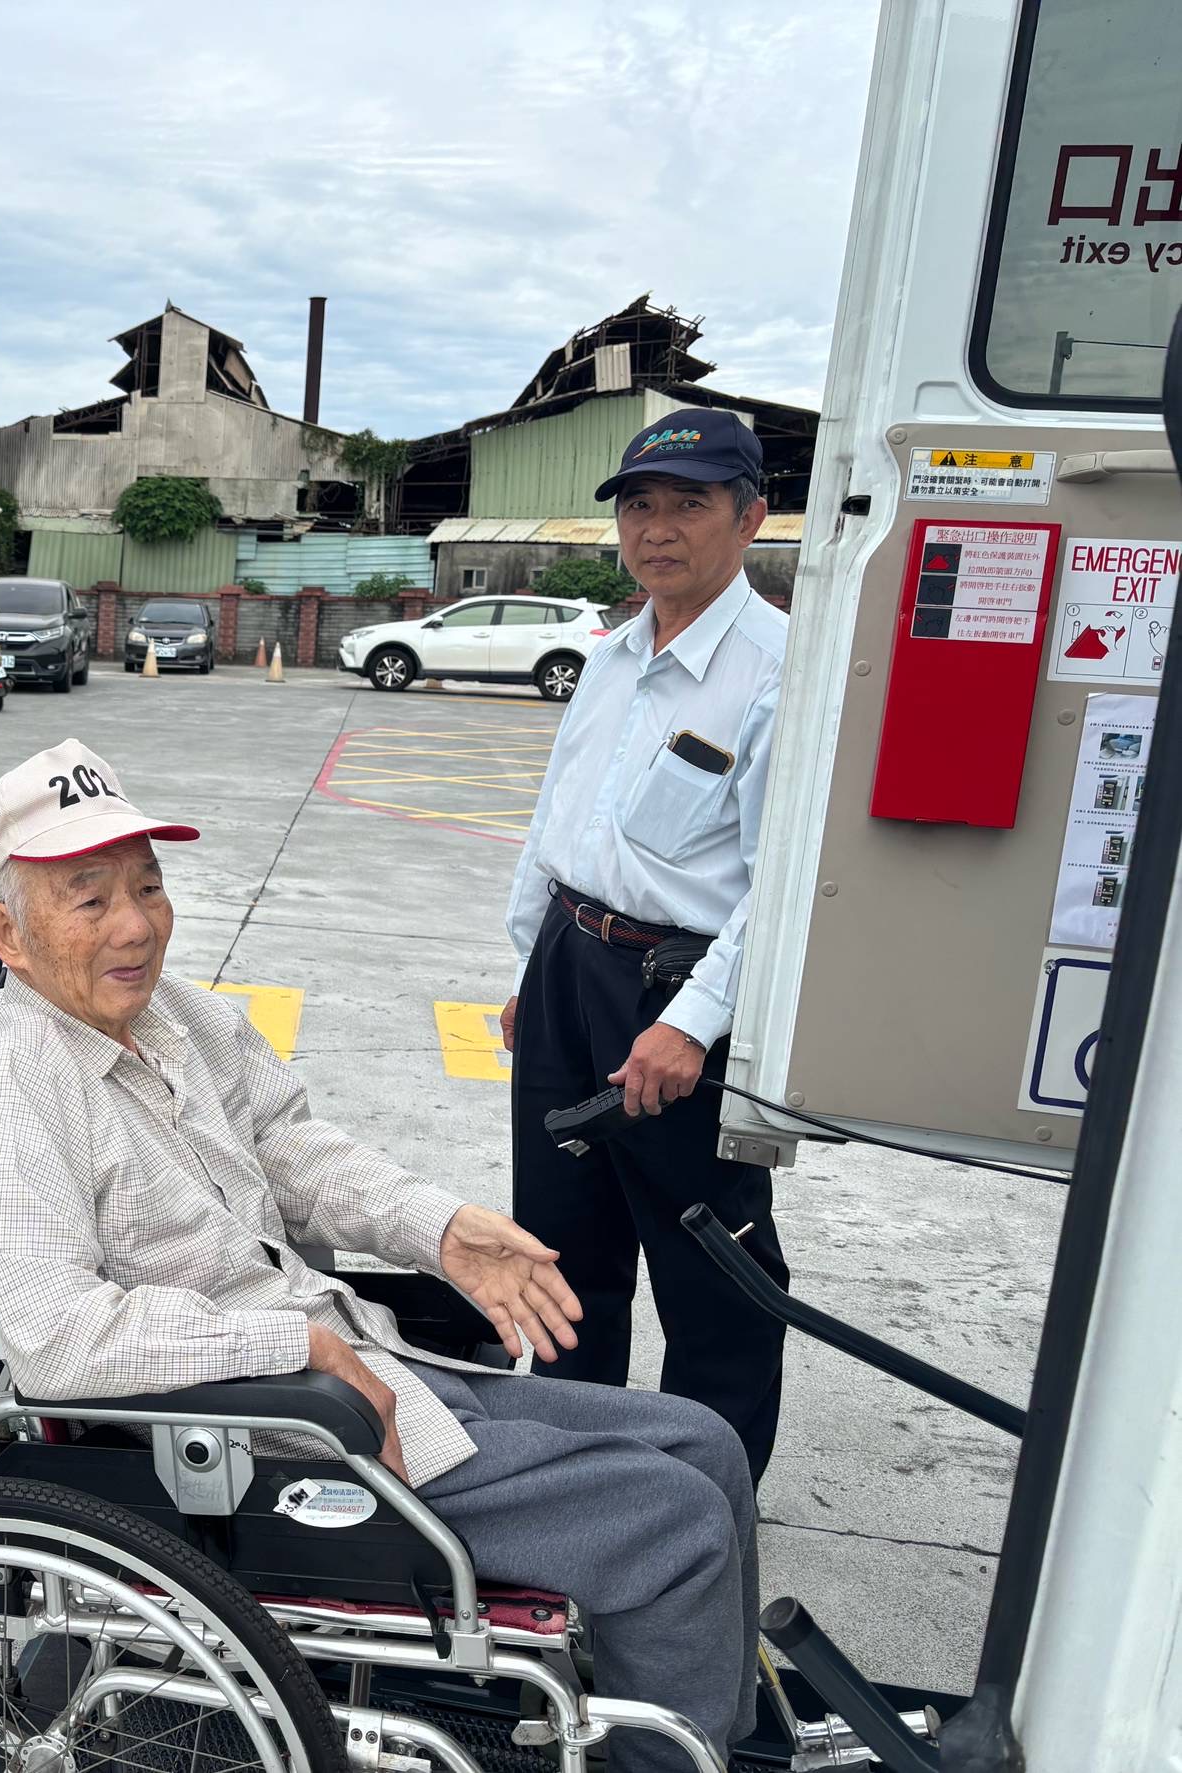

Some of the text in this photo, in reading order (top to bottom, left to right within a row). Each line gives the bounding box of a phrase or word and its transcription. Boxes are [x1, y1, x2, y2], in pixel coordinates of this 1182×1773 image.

[936, 529, 1038, 545] 緊急出口操作說明
[1071, 546, 1182, 575] EMERGEN
[1112, 576, 1161, 603] EXIT
